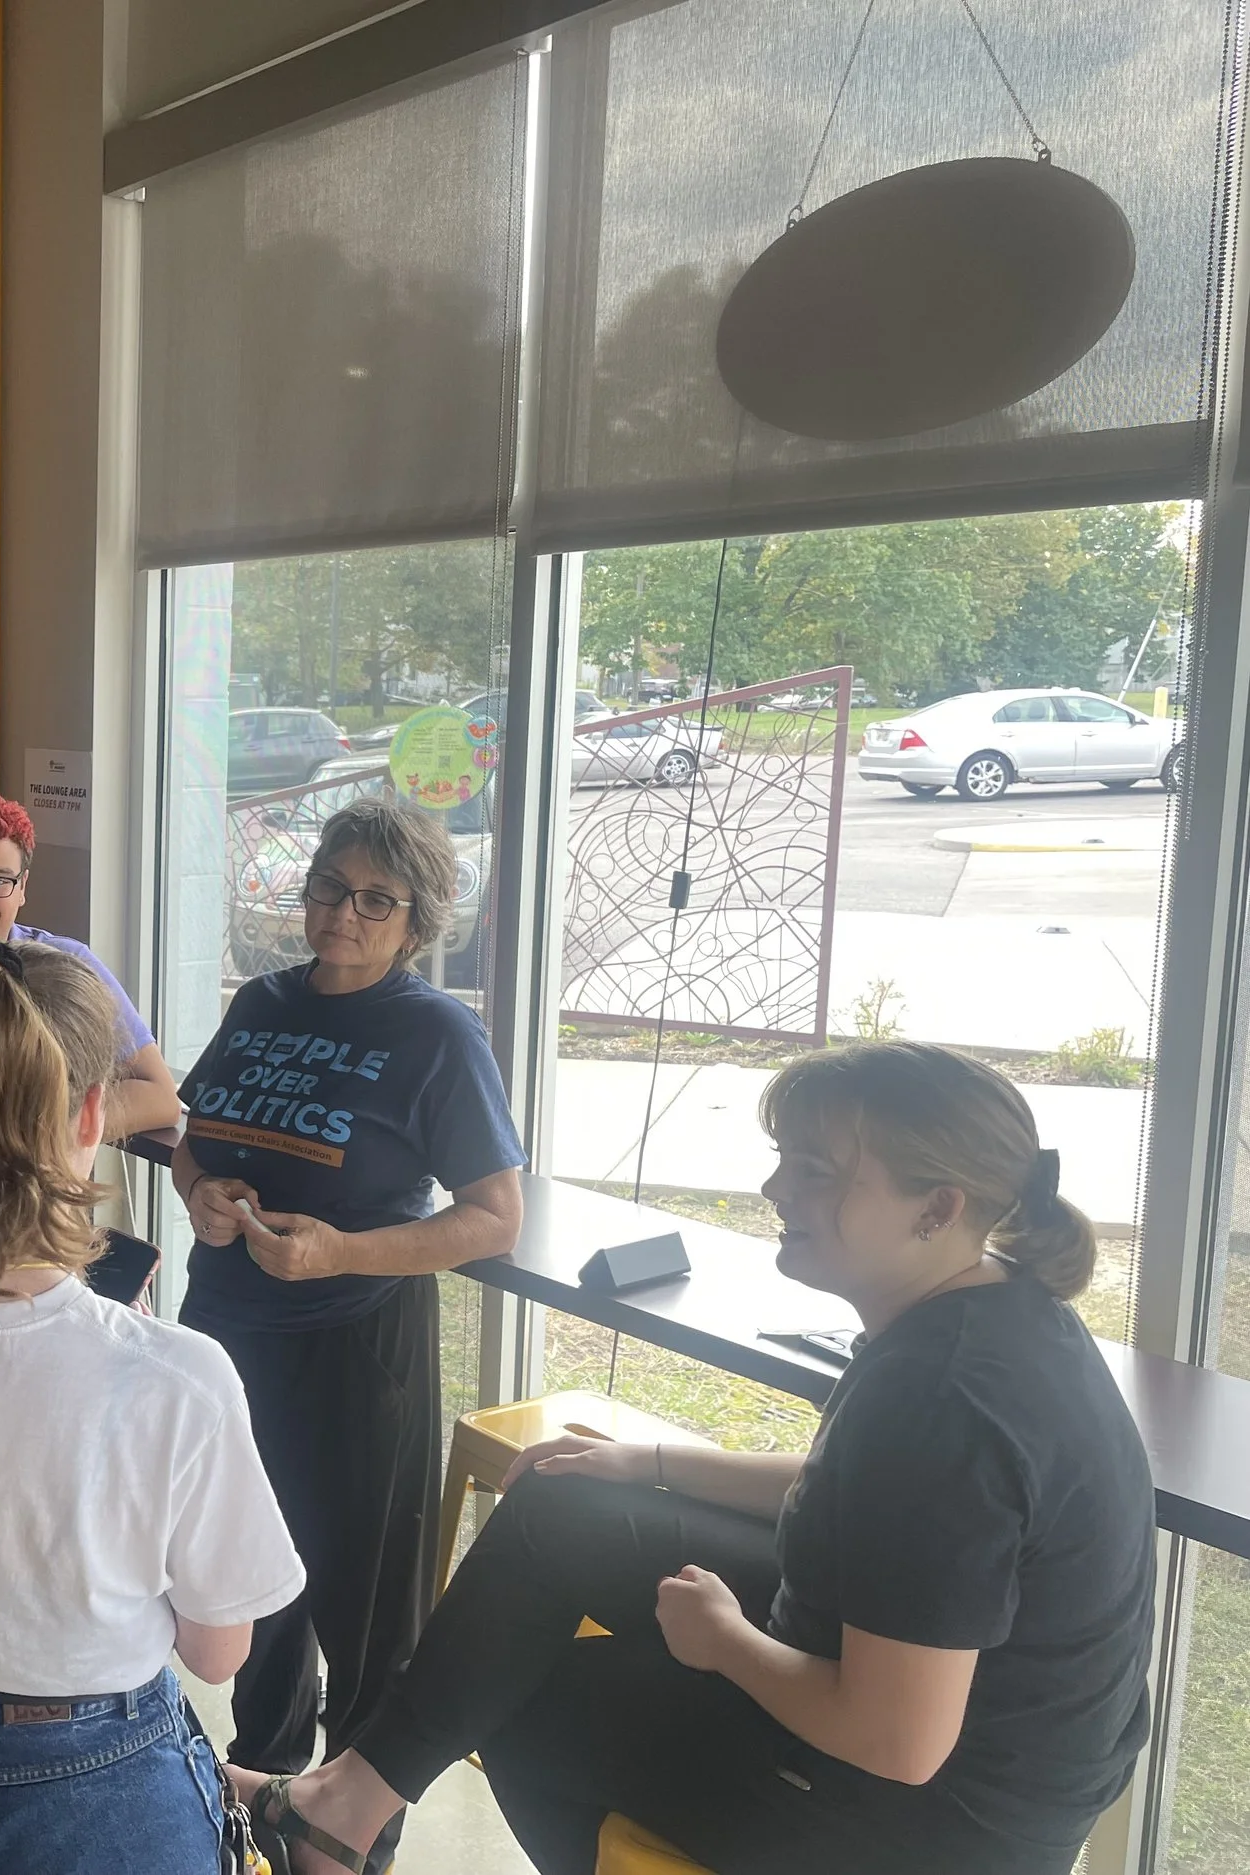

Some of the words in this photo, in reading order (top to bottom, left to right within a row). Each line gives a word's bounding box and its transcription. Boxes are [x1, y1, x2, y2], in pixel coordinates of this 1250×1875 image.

[30, 784, 42, 793] THE
[43, 785, 68, 796] LOUNGE
[69, 788, 86, 798] AREA
[34, 799, 56, 808] CLOSES
[58, 801, 66, 809] AT
[67, 802, 81, 812] 7PM
[238, 1064, 319, 1095] OVER
[229, 1130, 255, 1142] County
[257, 1135, 279, 1147] Chairs
[282, 1140, 332, 1160] Association
